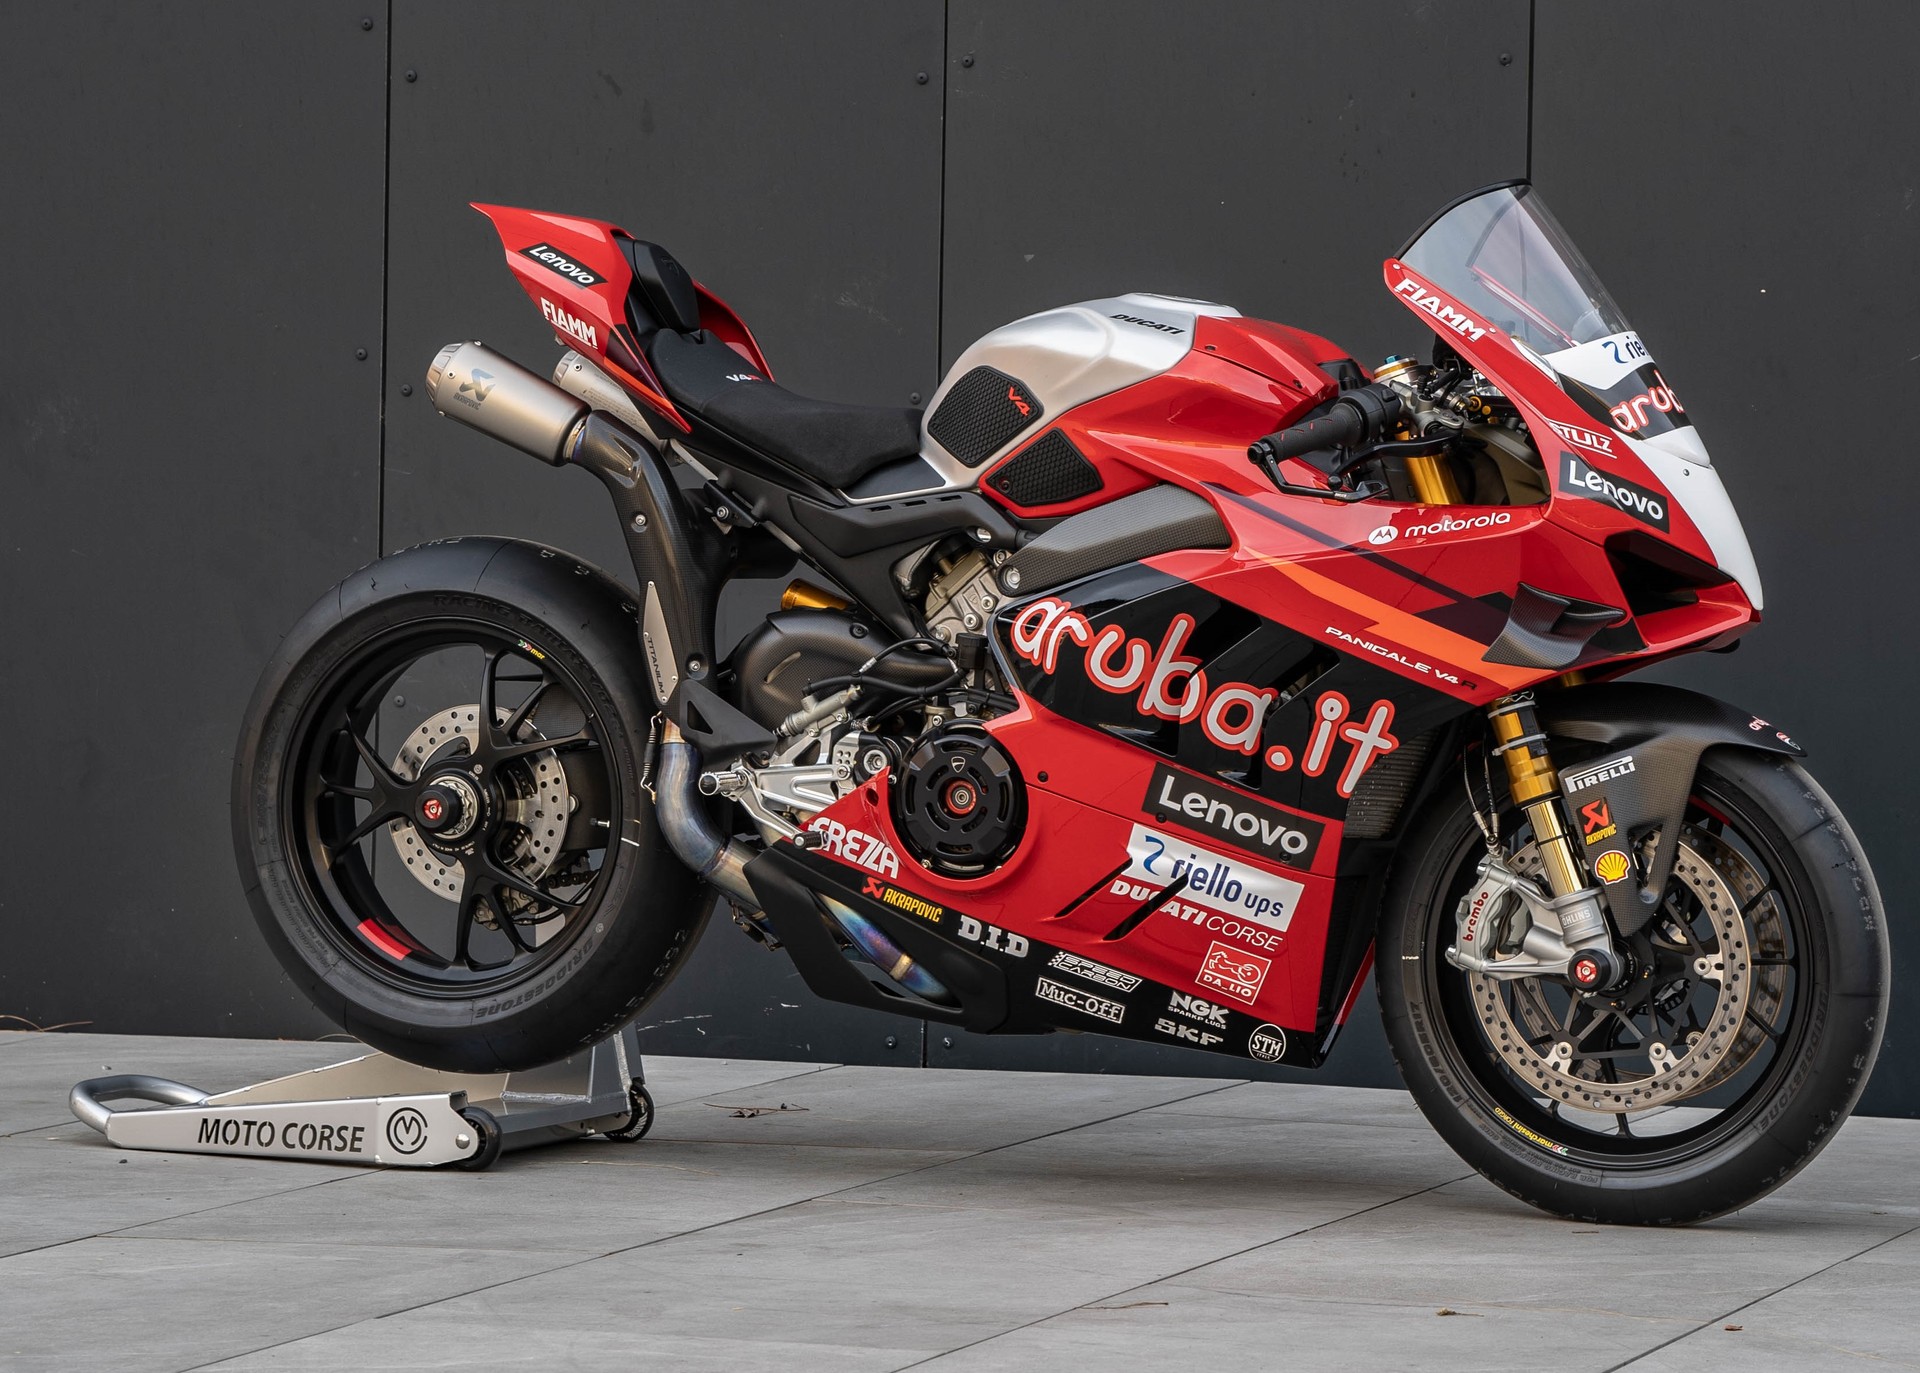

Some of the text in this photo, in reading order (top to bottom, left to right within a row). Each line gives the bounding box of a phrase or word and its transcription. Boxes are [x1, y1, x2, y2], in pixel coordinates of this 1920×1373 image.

[529, 245, 594, 283] Lenovo
[541, 297, 598, 348] FIAMM
[1110, 313, 1184, 335] DUCATI
[1395, 277, 1486, 341] FIAMM
[1007, 386, 1029, 416] V4
[1569, 459, 1664, 520] Lenovo
[1405, 512, 1511, 538] motorola
[647, 637, 665, 693] TITANIUM
[1325, 626, 1432, 674] PANIGALE
[1011, 596, 1398, 800] aruba.it
[1565, 755, 1636, 793] PIRELLI
[1158, 774, 1309, 855] Lenovo
[1170, 852, 1285, 917] riello ups
[1109, 880, 1284, 952] DUATI CORSE
[1462, 891, 1488, 942] brembo
[957, 914, 1029, 958] D.I.D
[1057, 962, 1133, 991] CARBON
[1064, 956, 1136, 985] SPEED
[1040, 982, 1121, 1020] Muc-Off
[1169, 990, 1230, 1024] NGK
[1154, 1017, 1224, 1046] SKF
[1251, 1034, 1283, 1057] STM
[197, 1116, 365, 1153] MOTO CORSE
[1514, 1123, 1553, 1149] marchesini
